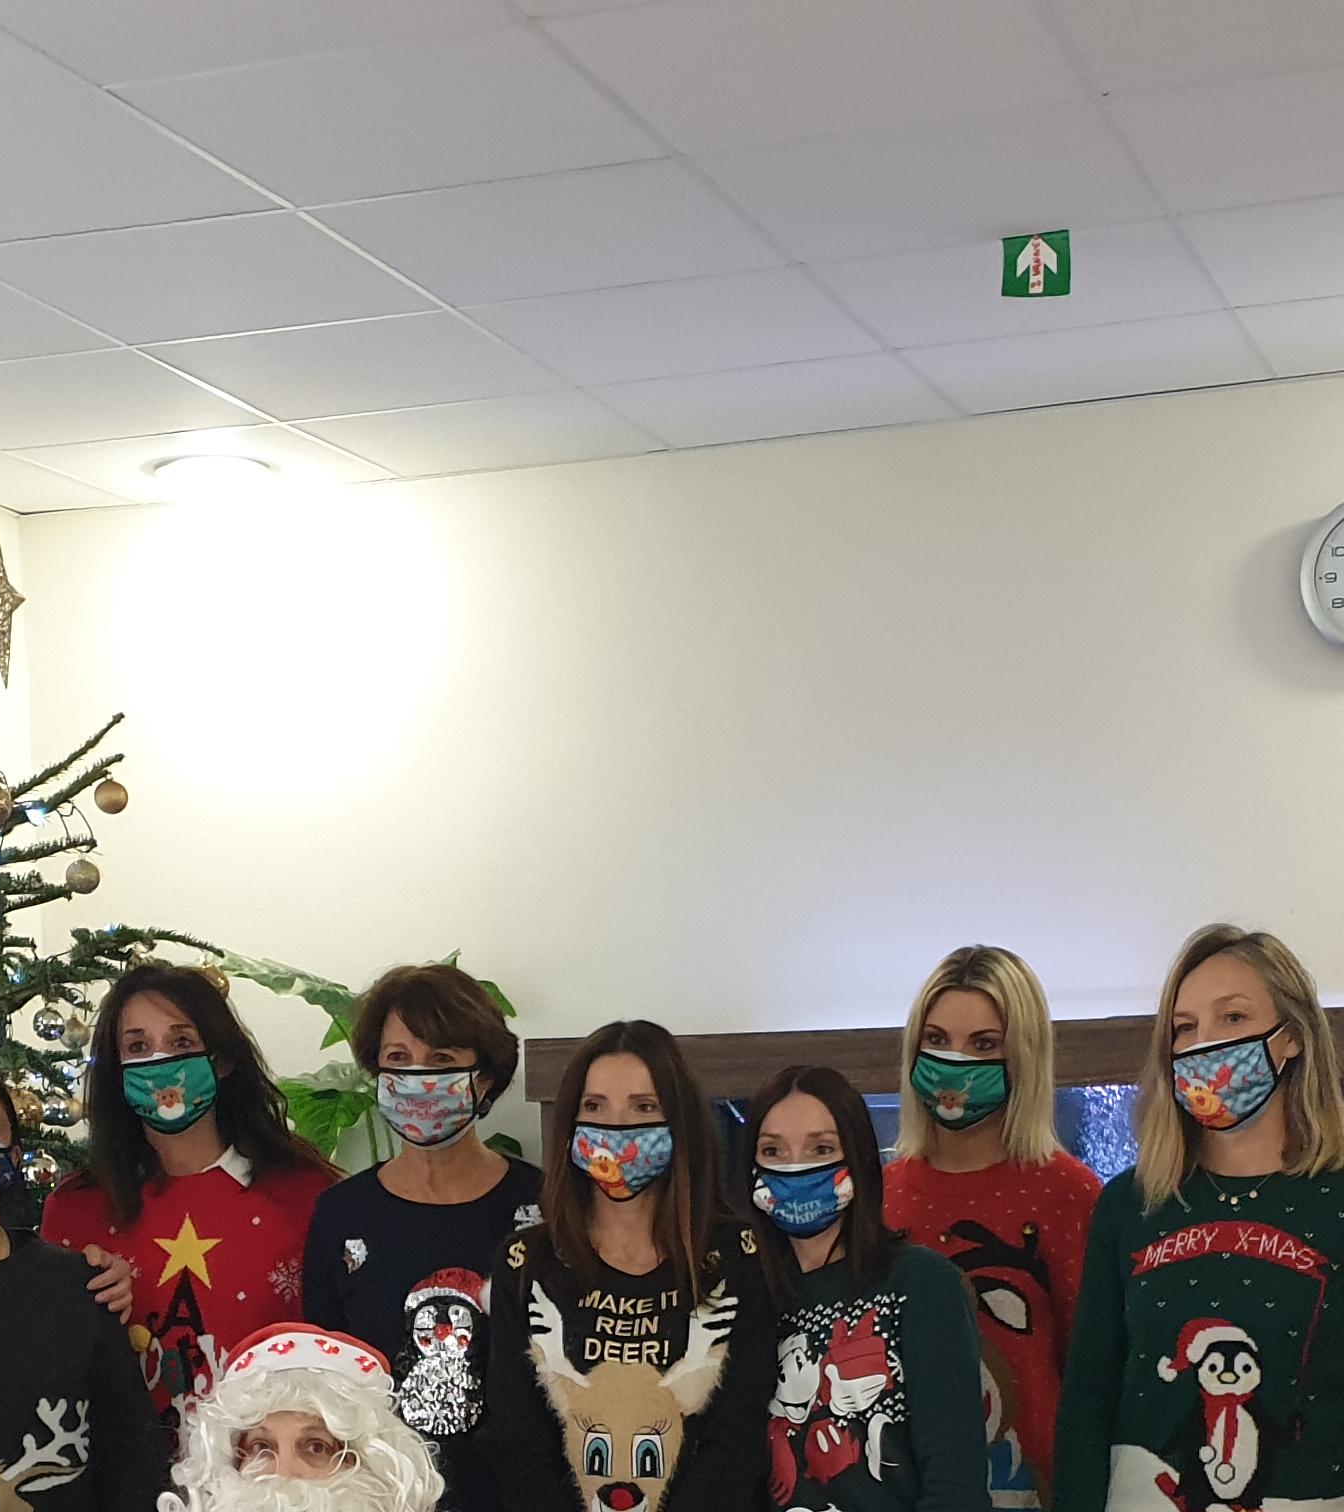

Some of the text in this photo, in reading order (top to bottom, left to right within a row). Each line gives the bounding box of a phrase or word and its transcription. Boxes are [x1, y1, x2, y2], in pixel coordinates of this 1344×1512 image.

[1324, 572, 1337, 584] 9
[1331, 597, 1344, 609] 8
[1143, 1226, 1315, 1270] MERRY X-MAS
[577, 1289, 679, 1315] MAKE IT
[595, 1315, 659, 1337] REIN
[583, 1337, 670, 1365] DEER!
